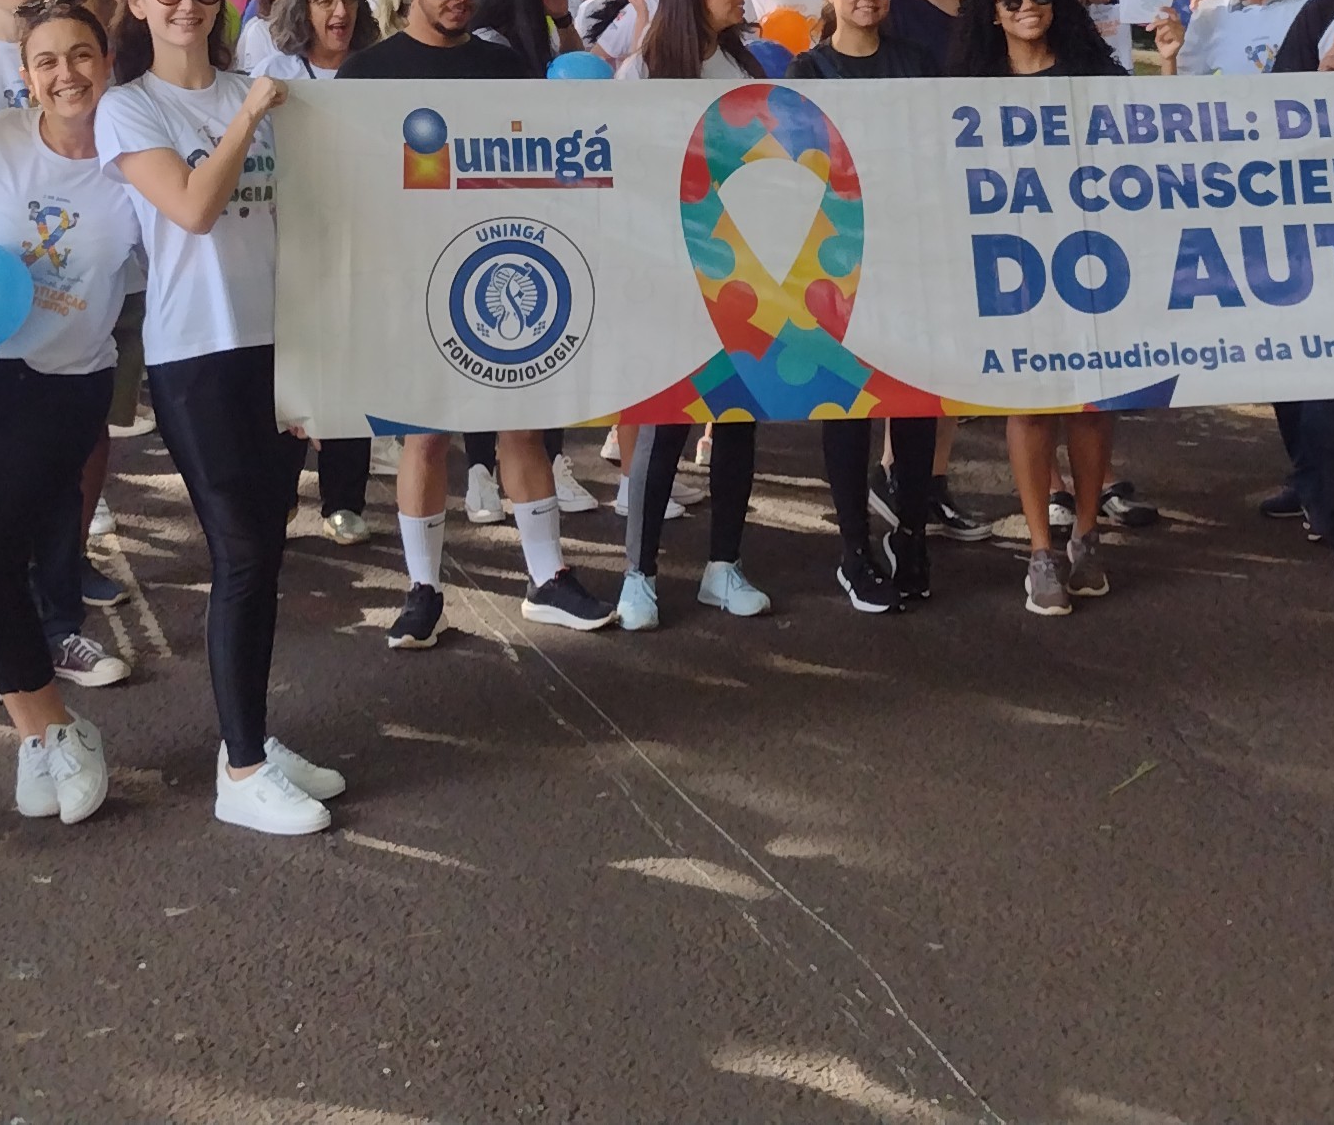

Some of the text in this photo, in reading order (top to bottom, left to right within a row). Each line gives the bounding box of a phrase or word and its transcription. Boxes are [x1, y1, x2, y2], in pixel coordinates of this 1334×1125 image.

[952, 105, 984, 148] 2
[1000, 105, 1071, 146] DE
[1086, 102, 1261, 145] ABRIL:
[454, 120, 613, 182] uningá
[966, 167, 1054, 215] DA
[475, 223, 547, 245] UNINGÁ
[971, 230, 1131, 317] DO
[443, 333, 580, 384] FONOAUDIOLOGIA
[982, 350, 1005, 374] A
[1012, 338, 1246, 373] Fonoaudiologia
[1255, 337, 1293, 362] da
